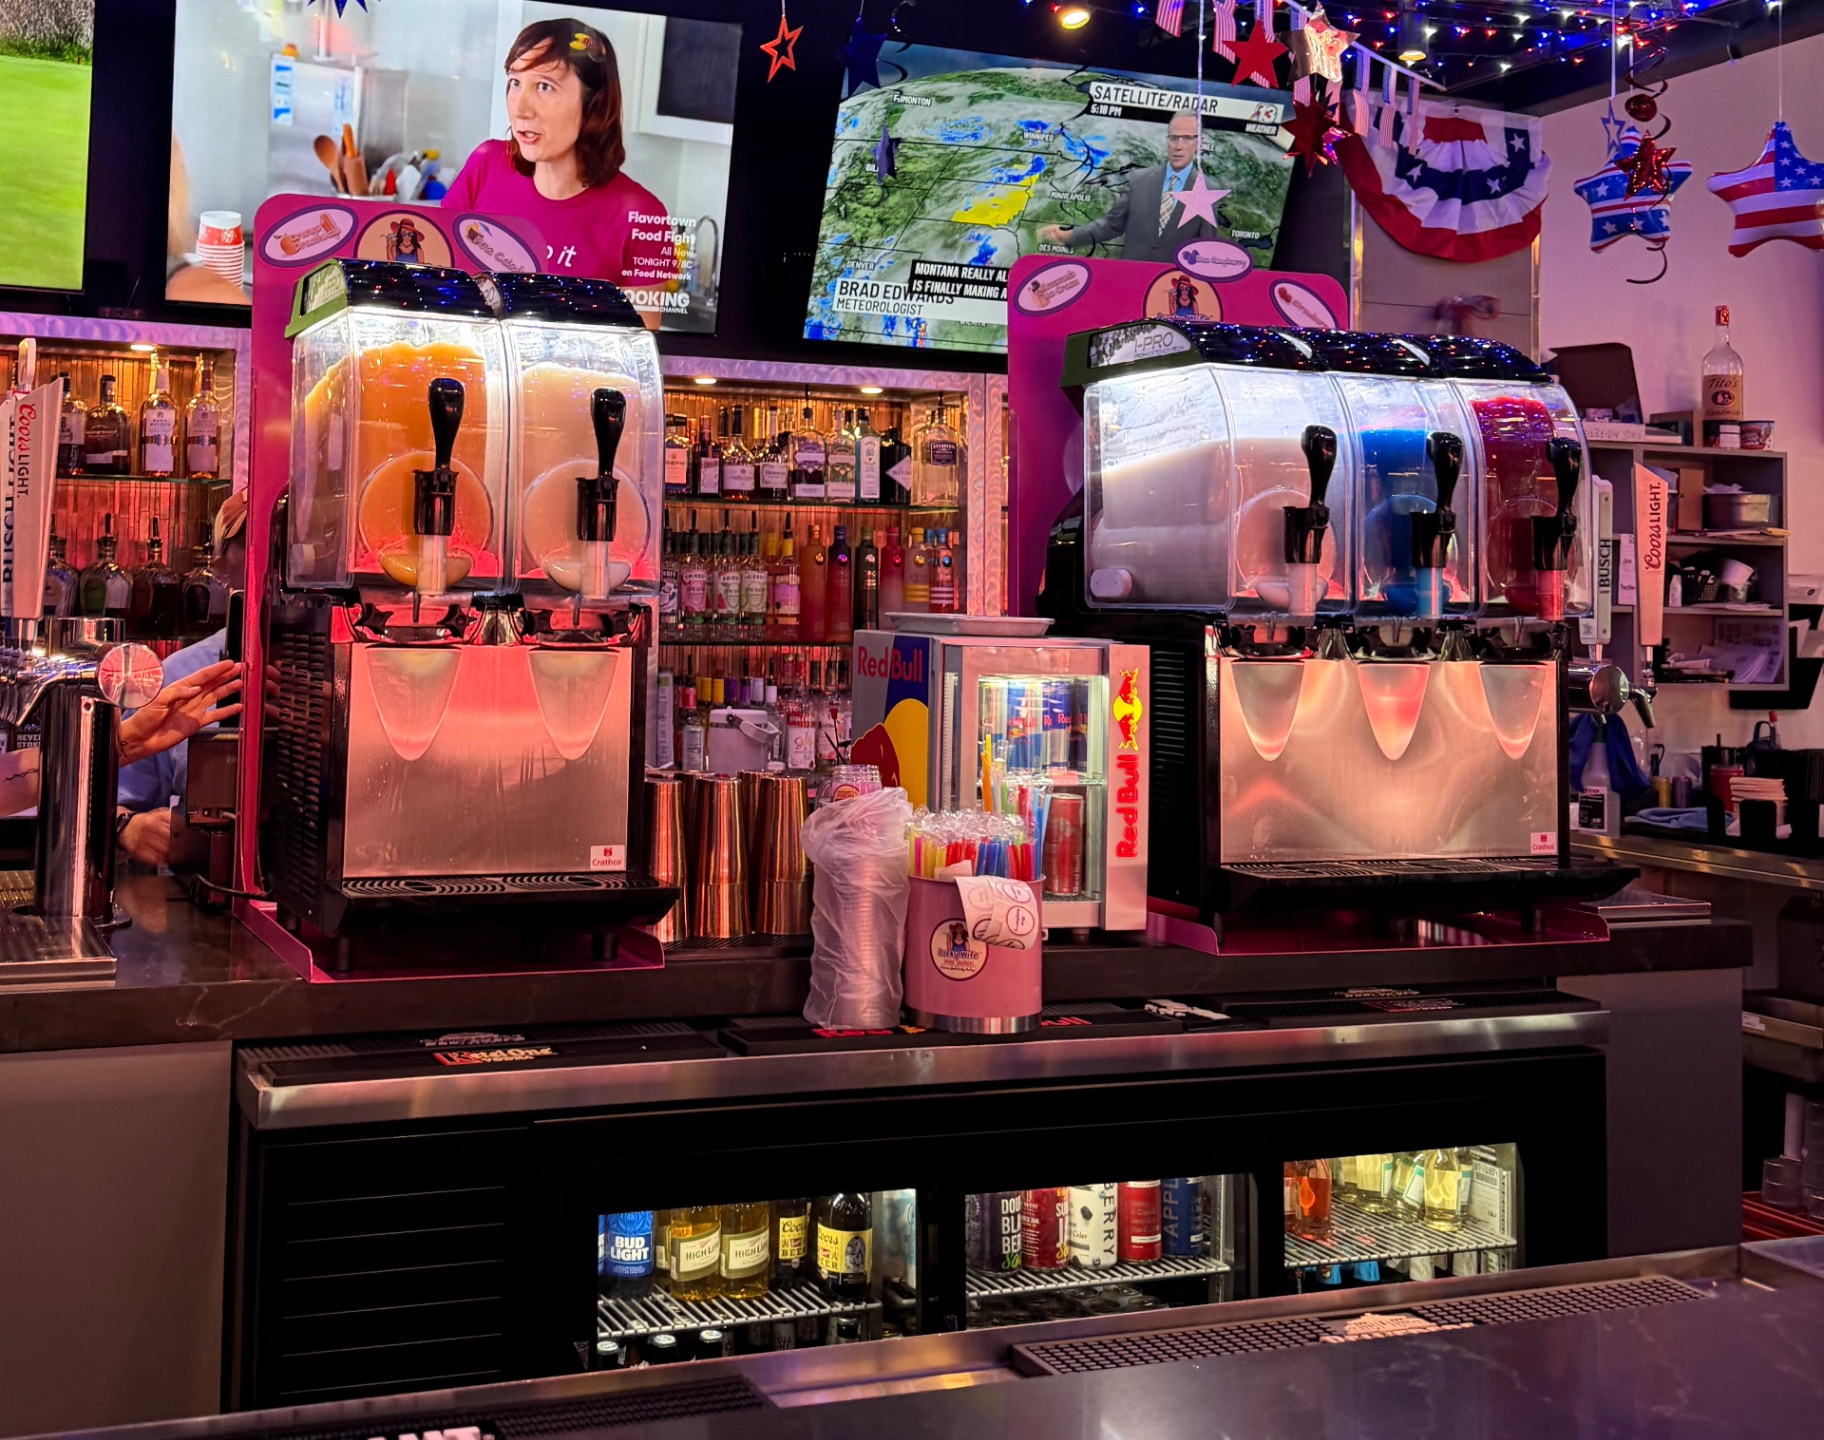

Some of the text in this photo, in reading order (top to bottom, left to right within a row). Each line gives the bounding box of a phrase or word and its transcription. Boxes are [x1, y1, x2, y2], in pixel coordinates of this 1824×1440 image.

[1093, 85, 1218, 113] SATELLITE/RADAR
[1109, 106, 1122, 116] PM
[1245, 123, 1277, 135] WEATHER
[1023, 131, 1054, 142] WINNIPEG
[1051, 190, 1091, 202] MINNEAPOLIS
[628, 211, 697, 227] Flavortown
[631, 228, 662, 242] Food
[1231, 229, 1261, 240] TORONTO
[661, 246, 672, 256] All
[1039, 243, 1051, 252] DES
[557, 245, 577, 267] it
[633, 256, 671, 268] TONIGHT
[846, 260, 876, 272] DENVER
[915, 262, 959, 279] MONTANA
[961, 266, 996, 282] REALLY
[621, 269, 692, 281] on Food Network
[838, 280, 880, 298] BRAD
[912, 279, 924, 292] IS
[924, 281, 963, 296] FINALLY
[963, 285, 1000, 300] MAKING
[626, 290, 691, 308] OOKING
[659, 306, 689, 315] CHANNEL
[836, 298, 925, 316] METEOROLOGIST
[1134, 331, 1174, 353] I-PRO
[1708, 376, 1739, 389] Tito's
[17, 403, 37, 452] Coors
[1643, 524, 1662, 570] Coors
[1599, 539, 1612, 588] BUSCH
[857, 646, 923, 682] Red Bull
[1116, 754, 1139, 858] Red Bull
[592, 858, 622, 866] Crathco
[615, 1235, 645, 1249] BUD
[610, 1246, 650, 1261] LIGHT
[685, 1249, 707, 1260] HIGH
[735, 1245, 756, 1258] HIGH
